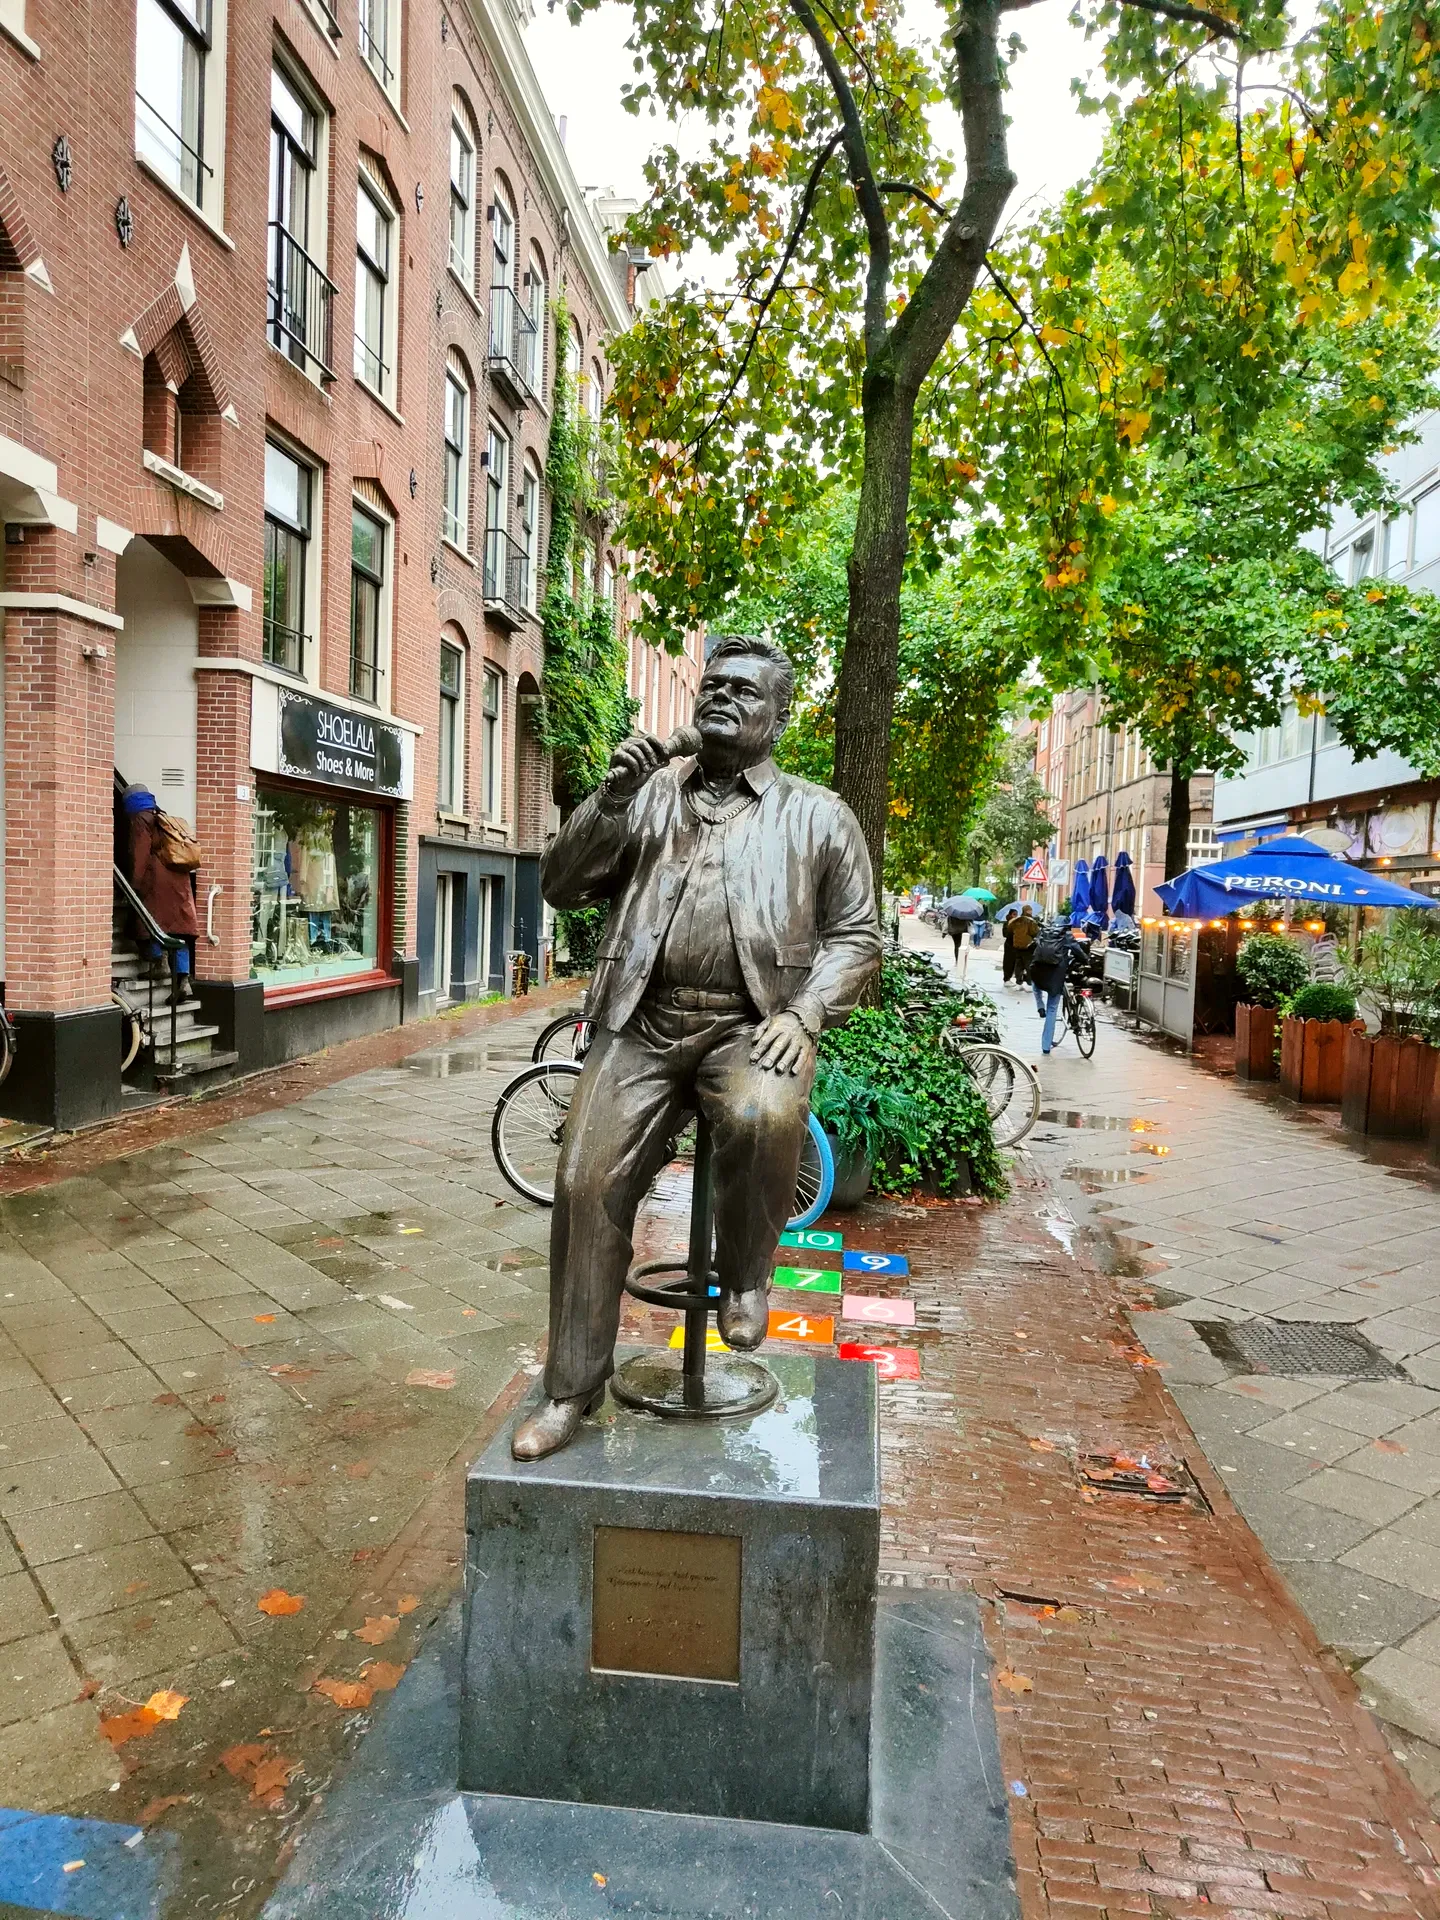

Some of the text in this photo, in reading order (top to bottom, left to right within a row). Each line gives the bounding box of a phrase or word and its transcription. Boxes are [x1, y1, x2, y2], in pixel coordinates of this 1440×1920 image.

[317, 711, 375, 753] SHOELALA
[316, 751, 375, 782] Shoes & More
[1225, 876, 1342, 895] PERONI
[789, 1231, 835, 1247] 10
[860, 1255, 891, 1271] 9
[793, 1270, 824, 1287] 7
[861, 1300, 896, 1318] 6
[776, 1316, 814, 1337] 4
[863, 1350, 897, 1373] 3
